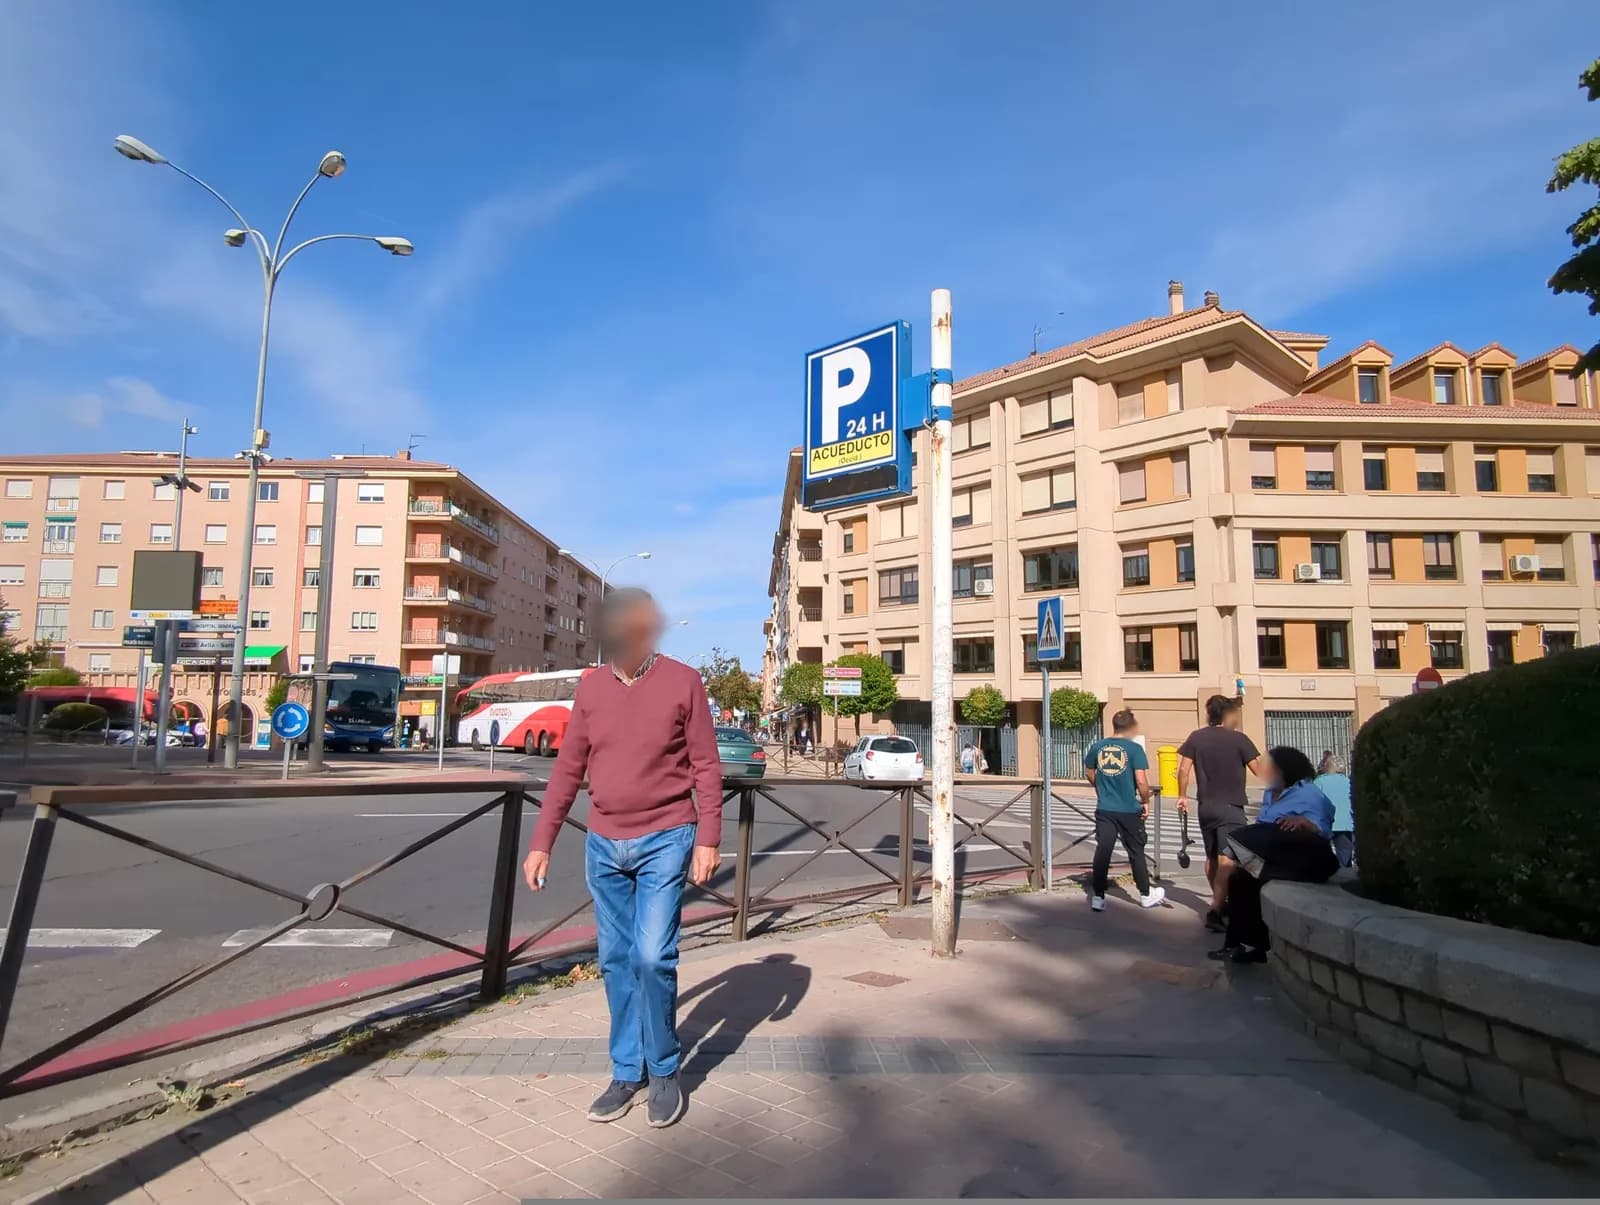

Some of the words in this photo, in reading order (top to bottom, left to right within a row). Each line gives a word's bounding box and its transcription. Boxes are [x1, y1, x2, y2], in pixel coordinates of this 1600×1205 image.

[822, 347, 871, 444] P
[846, 416, 867, 438] 24
[872, 410, 885, 432] H
[812, 432, 890, 462] ACUEDUCTO
